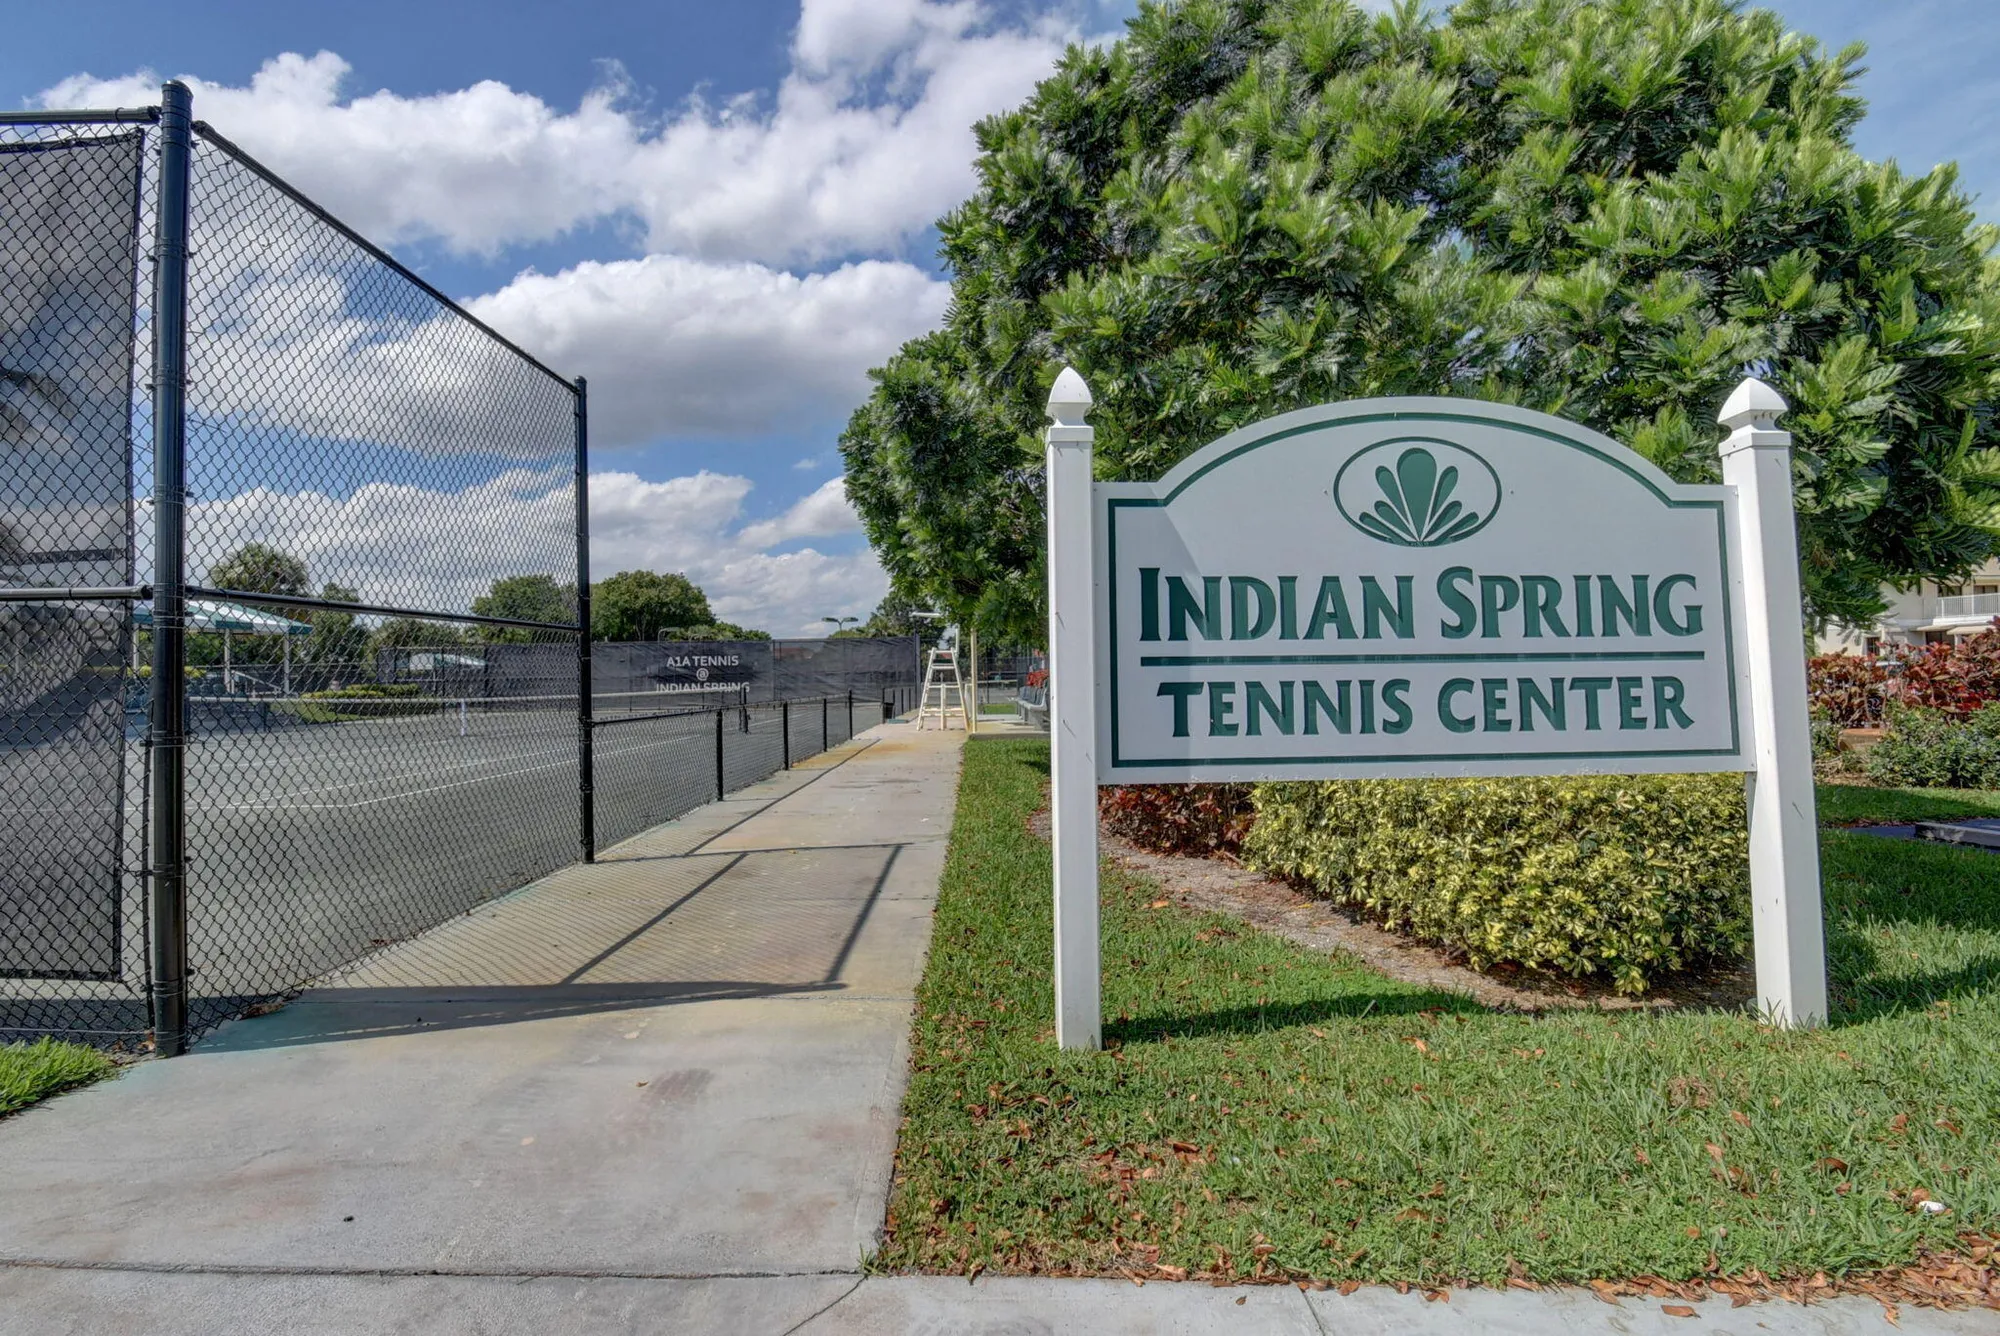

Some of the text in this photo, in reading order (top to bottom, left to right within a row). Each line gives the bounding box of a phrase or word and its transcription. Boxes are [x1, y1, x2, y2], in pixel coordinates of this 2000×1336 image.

[1138, 566, 1703, 642] INDIAN SPRING
[666, 655, 739, 667] A1A TENNIS
[696, 668, 709, 681] @
[656, 682, 750, 693] INDIAN SPRING
[1156, 675, 1695, 738] TENNIS CENTER
